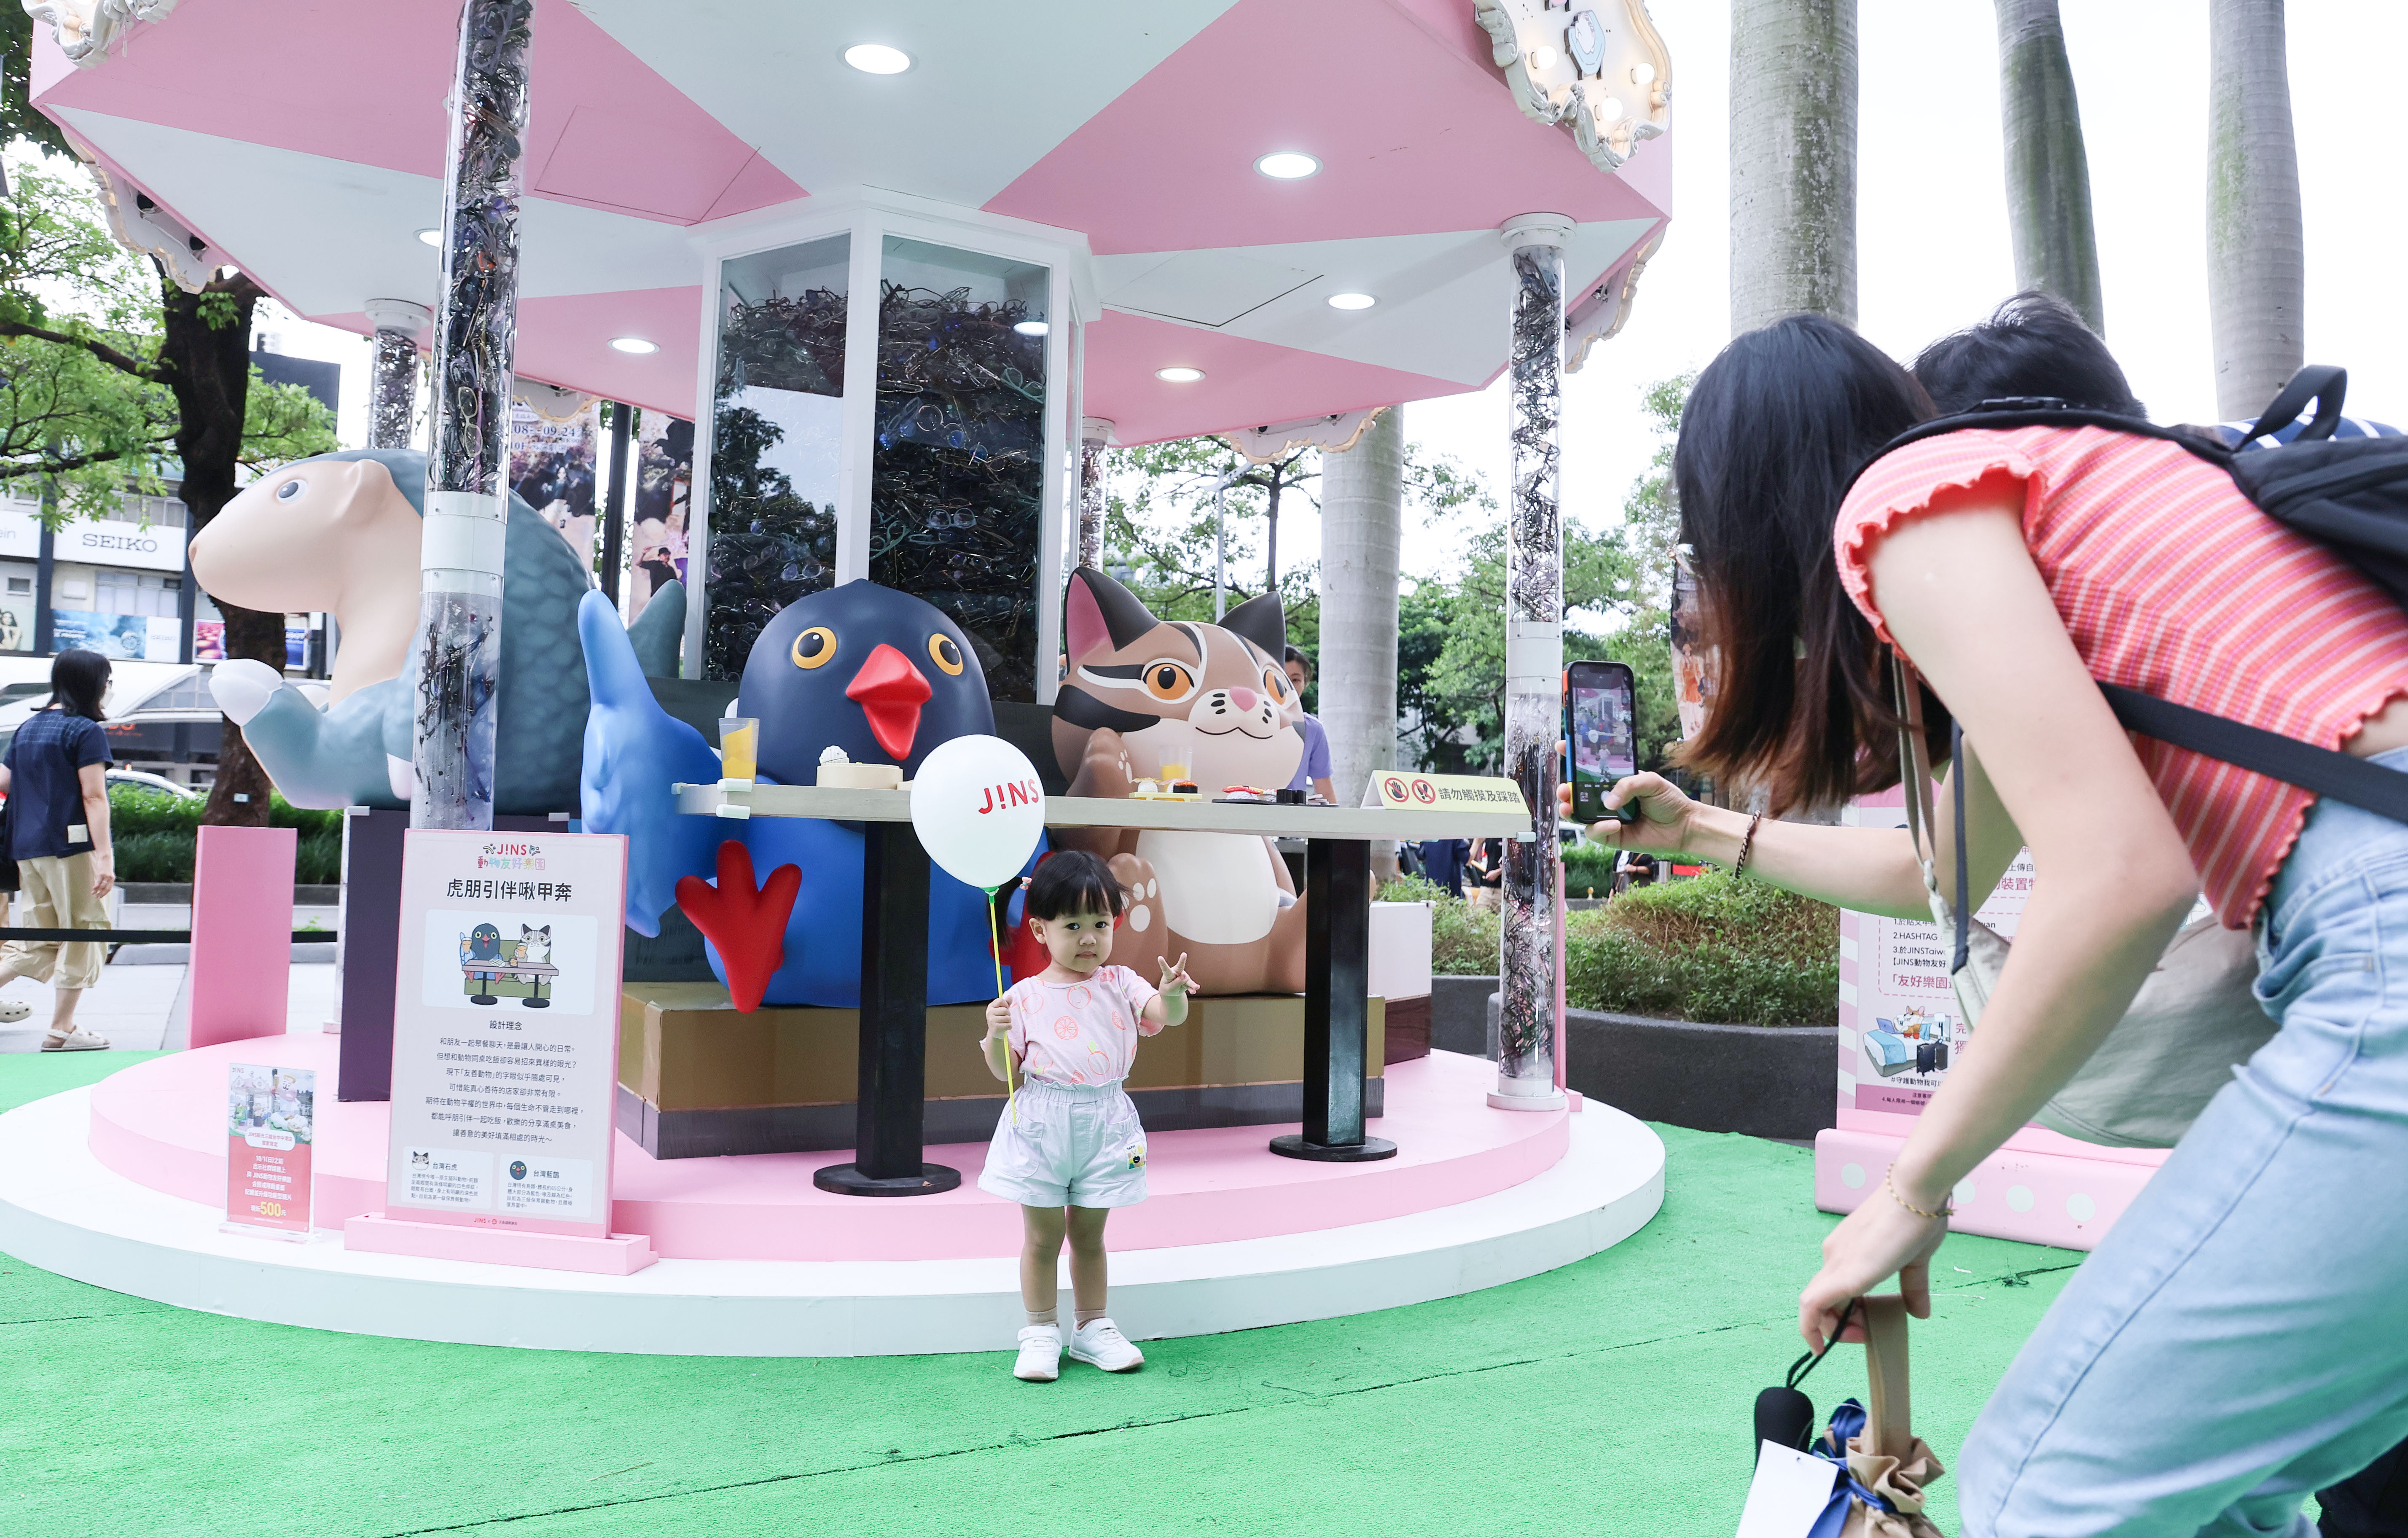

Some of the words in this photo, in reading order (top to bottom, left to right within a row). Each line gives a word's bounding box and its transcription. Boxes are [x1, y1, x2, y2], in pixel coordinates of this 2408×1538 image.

[82, 533, 158, 553] SEIKO
[1438, 787, 1521, 804] 請勿觸摸及踩踏
[477, 856, 545, 871] 動物友好樂園
[446, 878, 573, 902] 虎朋引伴啾甲奔
[1893, 932, 1938, 941] 2.HASHTAG
[489, 1020, 522, 1031] 設計理念
[433, 1162, 457, 1171] 台灣石虎
[534, 1170, 559, 1179] 台灣藍鵲
